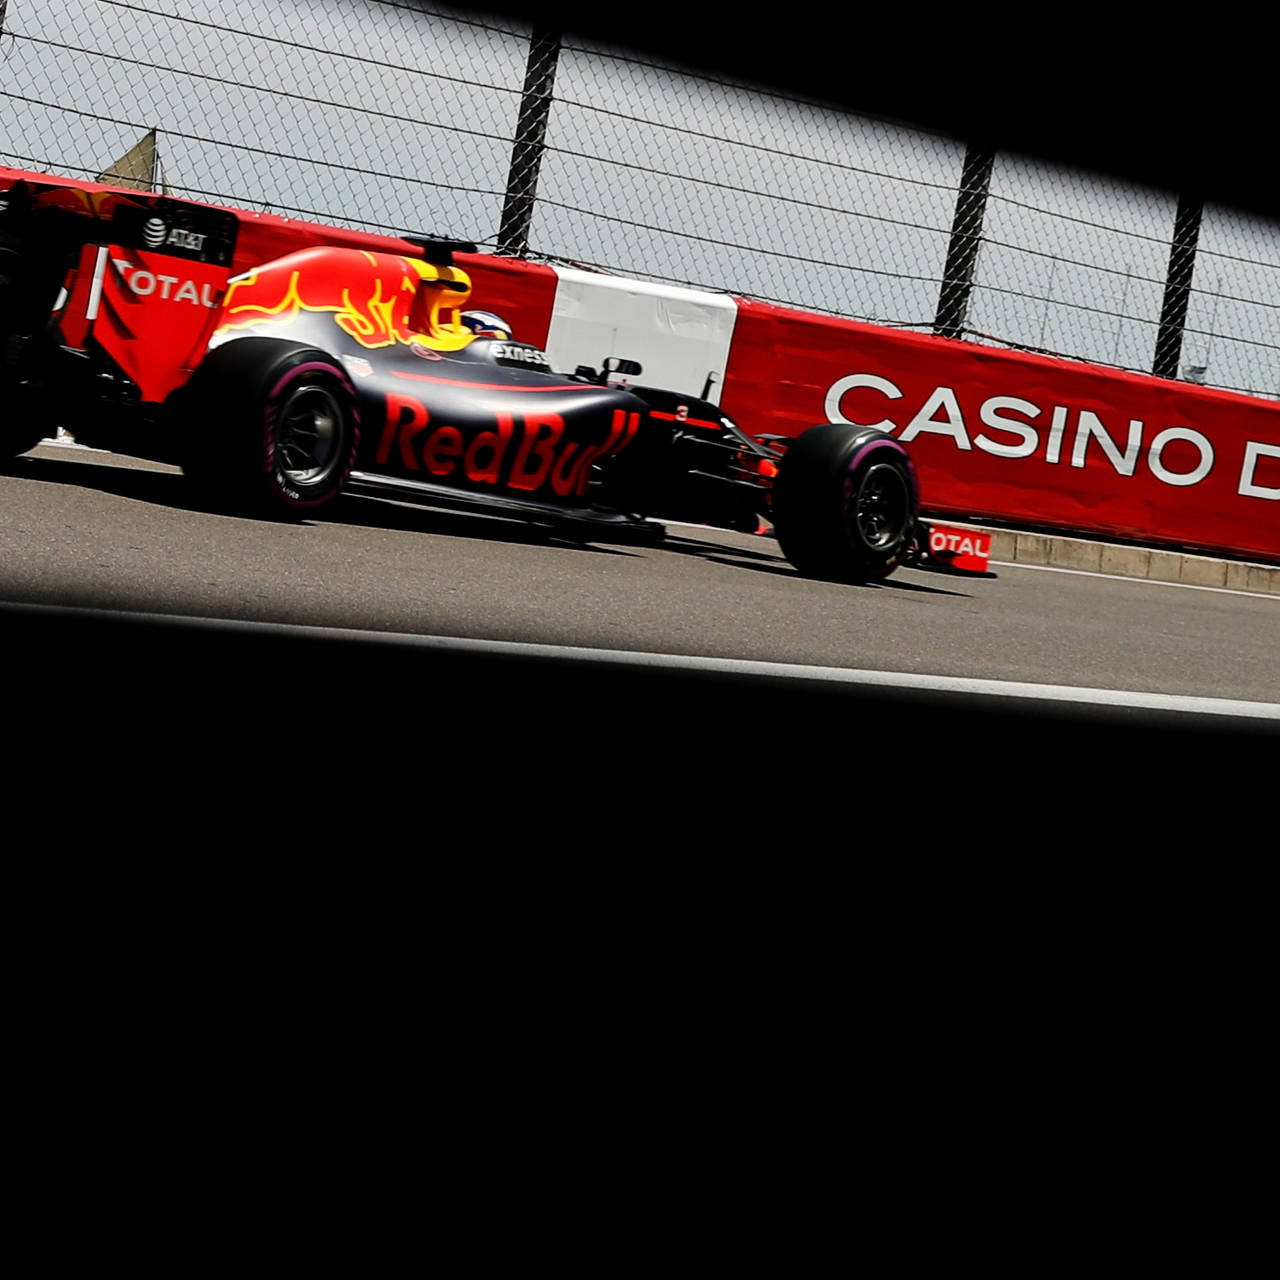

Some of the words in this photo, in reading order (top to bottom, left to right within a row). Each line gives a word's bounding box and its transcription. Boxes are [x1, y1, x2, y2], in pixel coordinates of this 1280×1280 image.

[166, 228, 207, 251] AT&T
[675, 404, 690, 422] 3
[824, 373, 1215, 487] CASINO
[929, 527, 989, 558] OTAL
